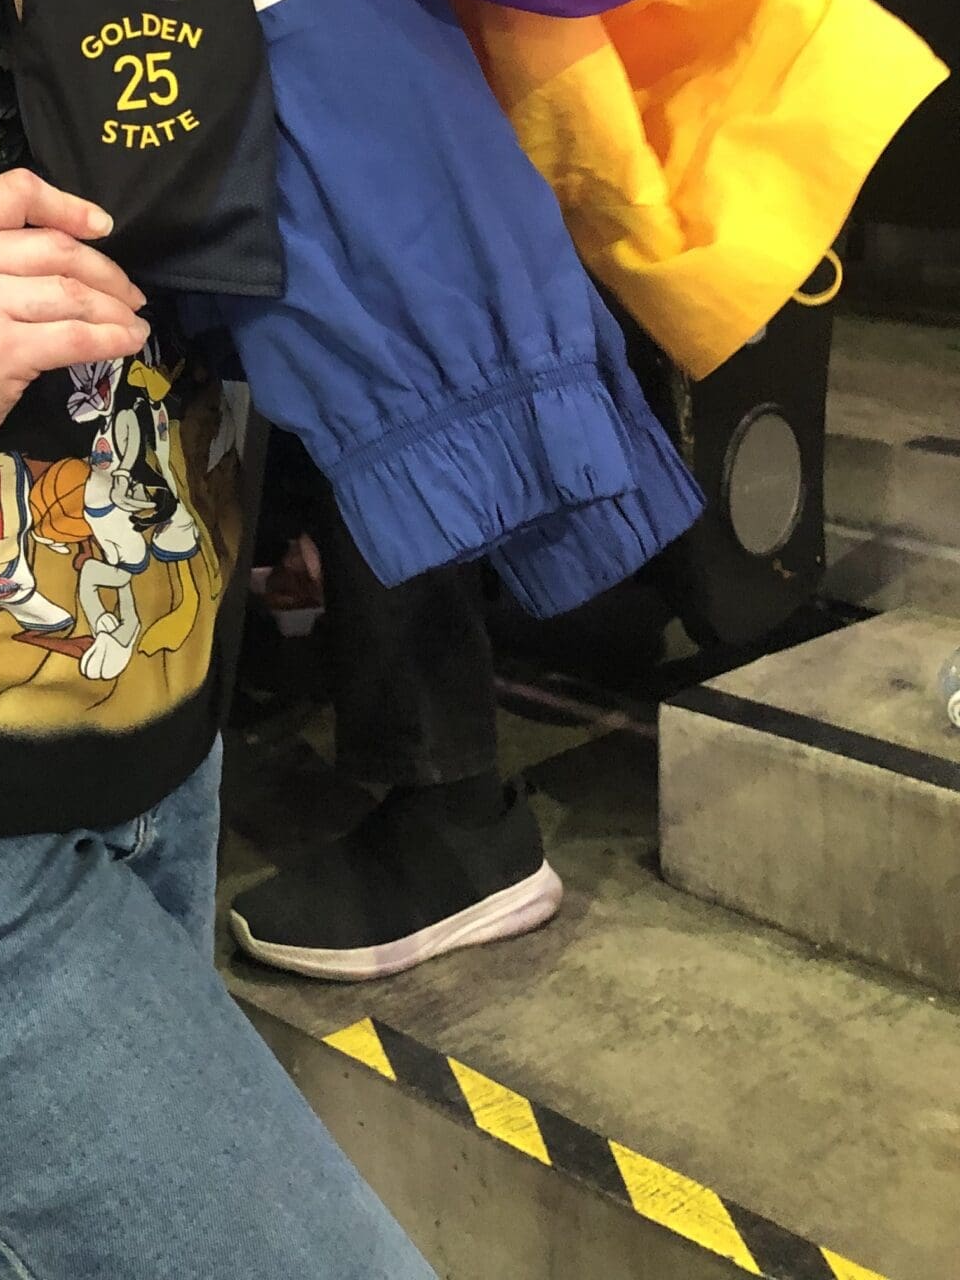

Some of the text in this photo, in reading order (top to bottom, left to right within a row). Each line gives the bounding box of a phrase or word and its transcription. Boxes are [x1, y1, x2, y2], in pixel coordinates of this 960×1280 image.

[81, 13, 203, 59] GOLDEN
[113, 52, 179, 111] 25
[102, 109, 200, 149] STATE
